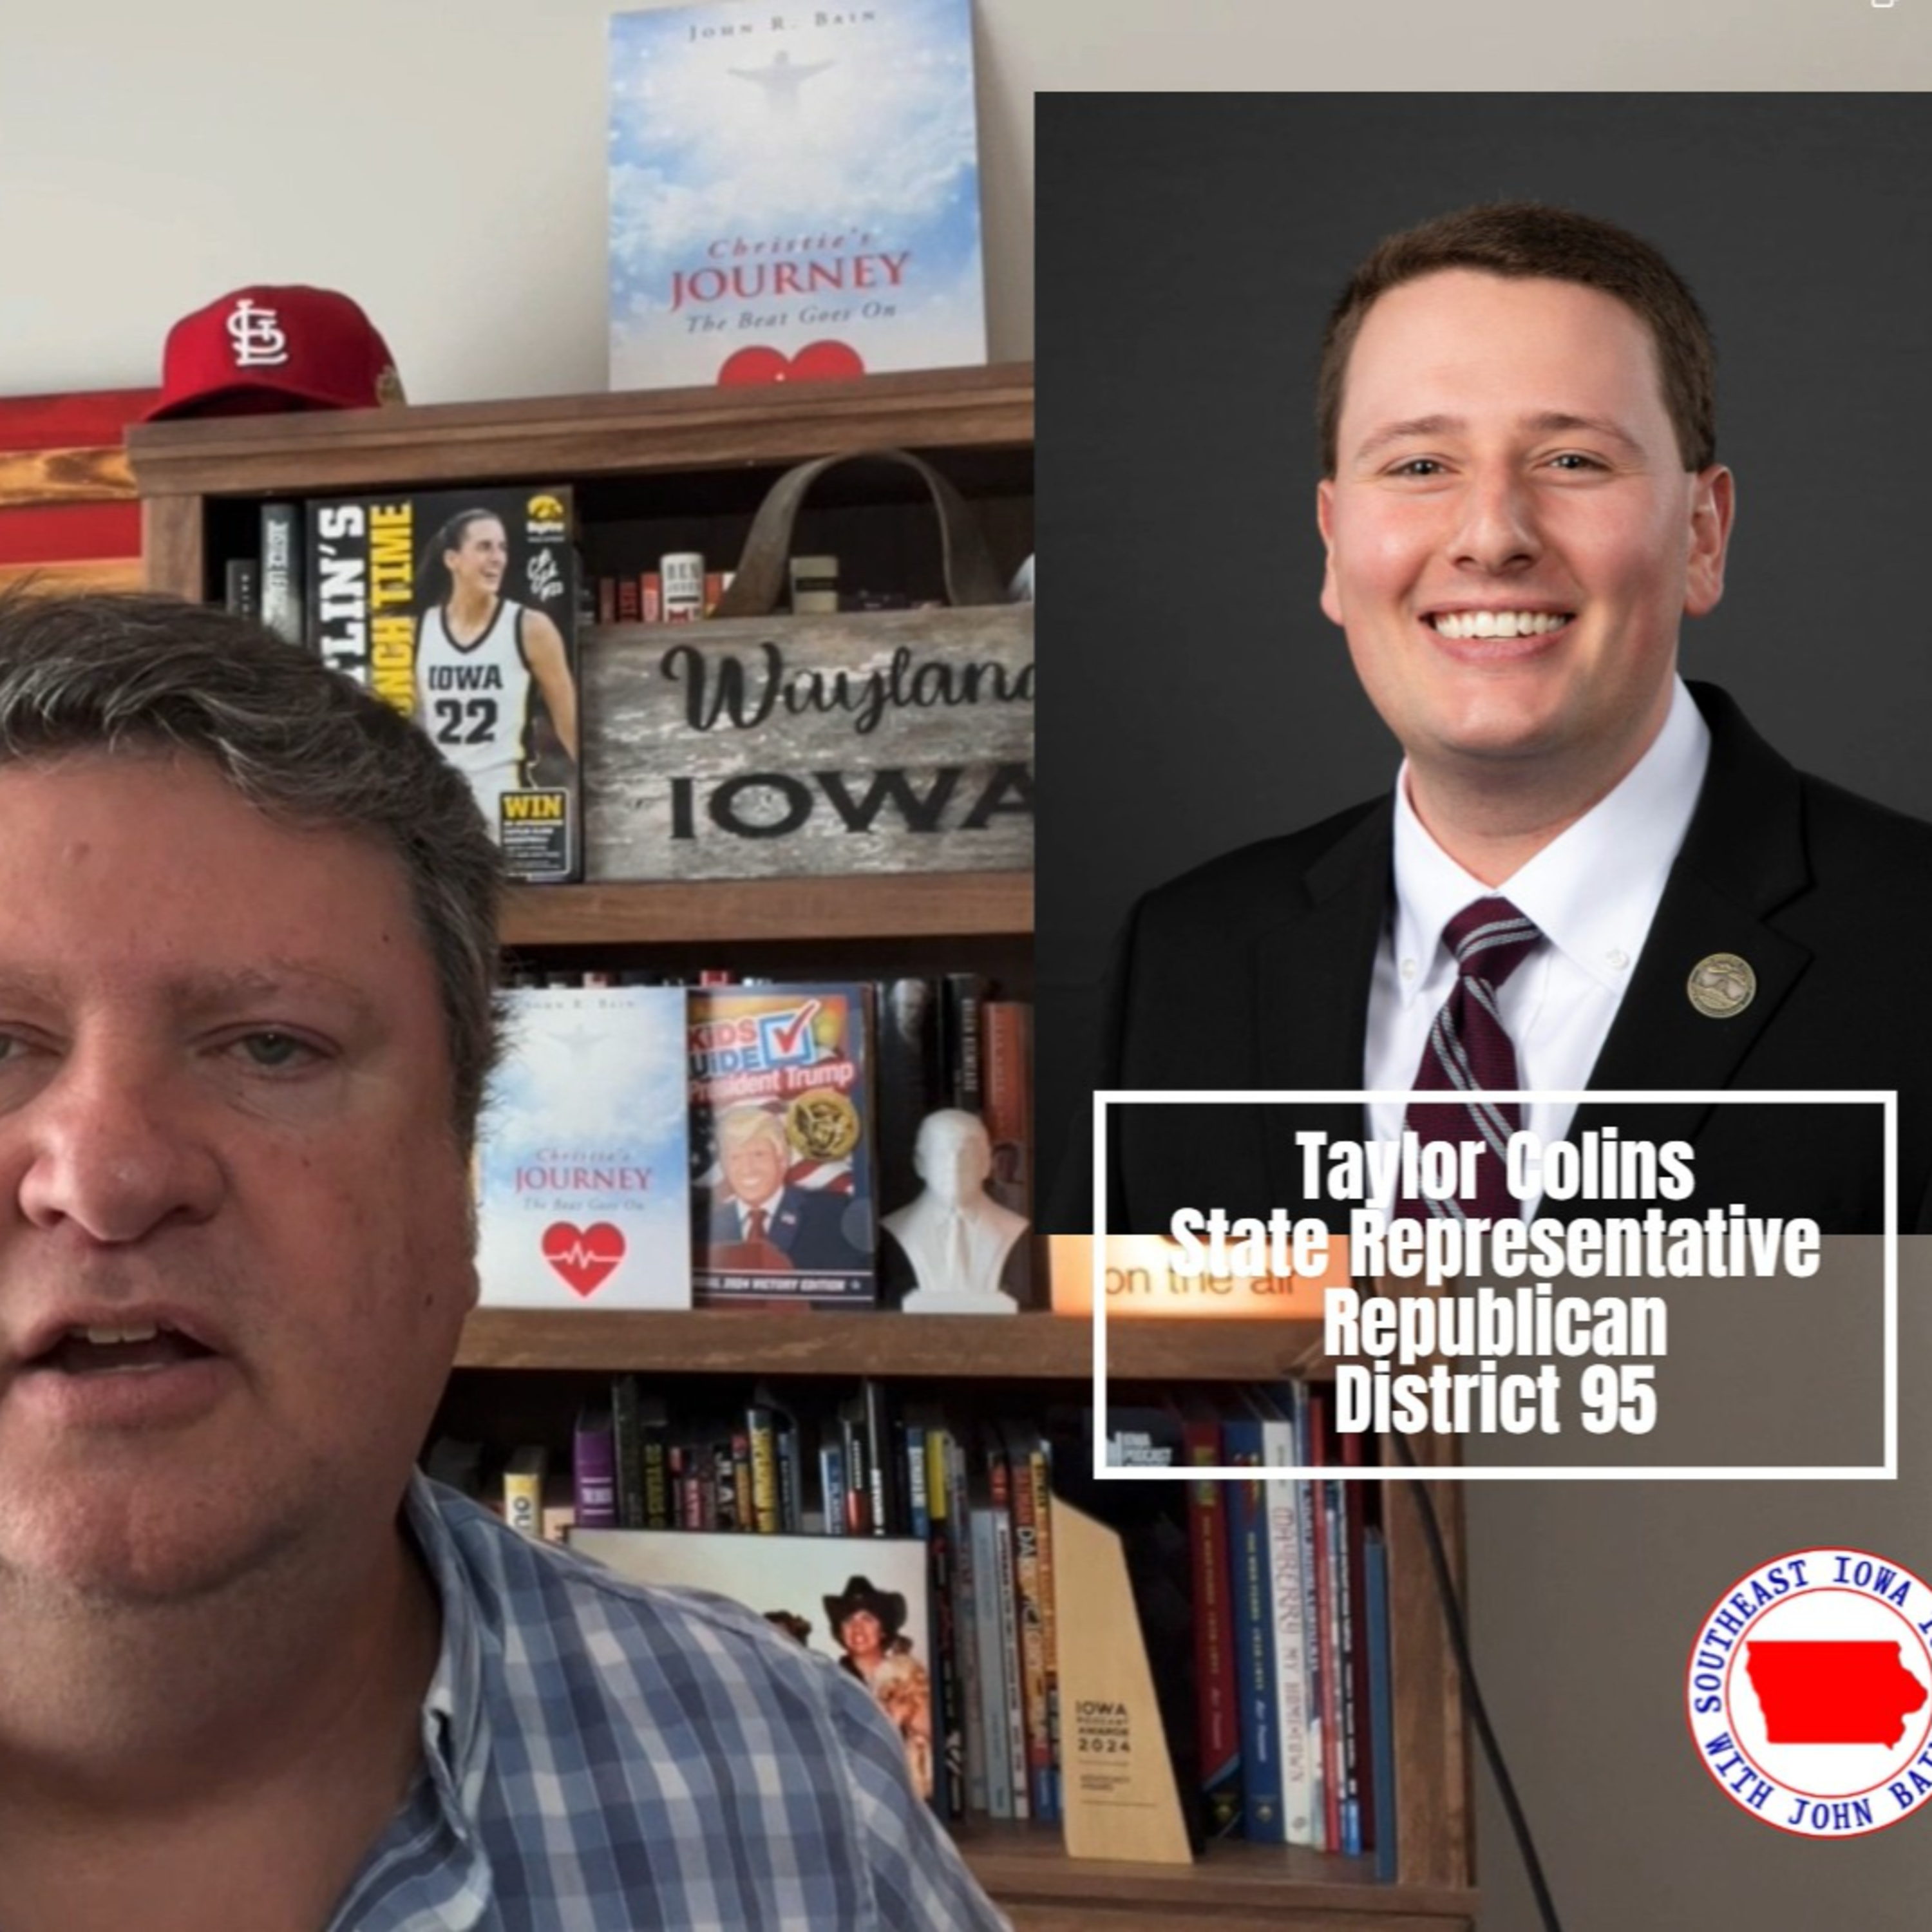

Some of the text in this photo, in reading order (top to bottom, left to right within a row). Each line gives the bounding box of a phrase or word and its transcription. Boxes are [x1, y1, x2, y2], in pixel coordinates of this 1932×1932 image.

[708, 227, 871, 259] Christie's
[669, 251, 911, 312] JOURNEY
[687, 300, 896, 334] The Beat Goes On
[369, 503, 412, 609] TIME
[428, 664, 503, 690] IOWA
[434, 698, 498, 744] 22
[503, 794, 562, 818] WIN
[669, 761, 1034, 838] IOWA
[784, 1061, 854, 1091] Trump
[515, 1167, 652, 1193] JOURNEY
[752, 1278, 799, 1291] VICTORY
[800, 1278, 846, 1292] EDITION
[1104, 1267, 1150, 1294] on
[1016, 1526, 1037, 1582] DARK
[1273, 1506, 1301, 1636] MAYBERRY
[1282, 1647, 1298, 1672] MY
[1075, 1700, 1127, 1715] IOWA
[1078, 1738, 1131, 1753] 2024
